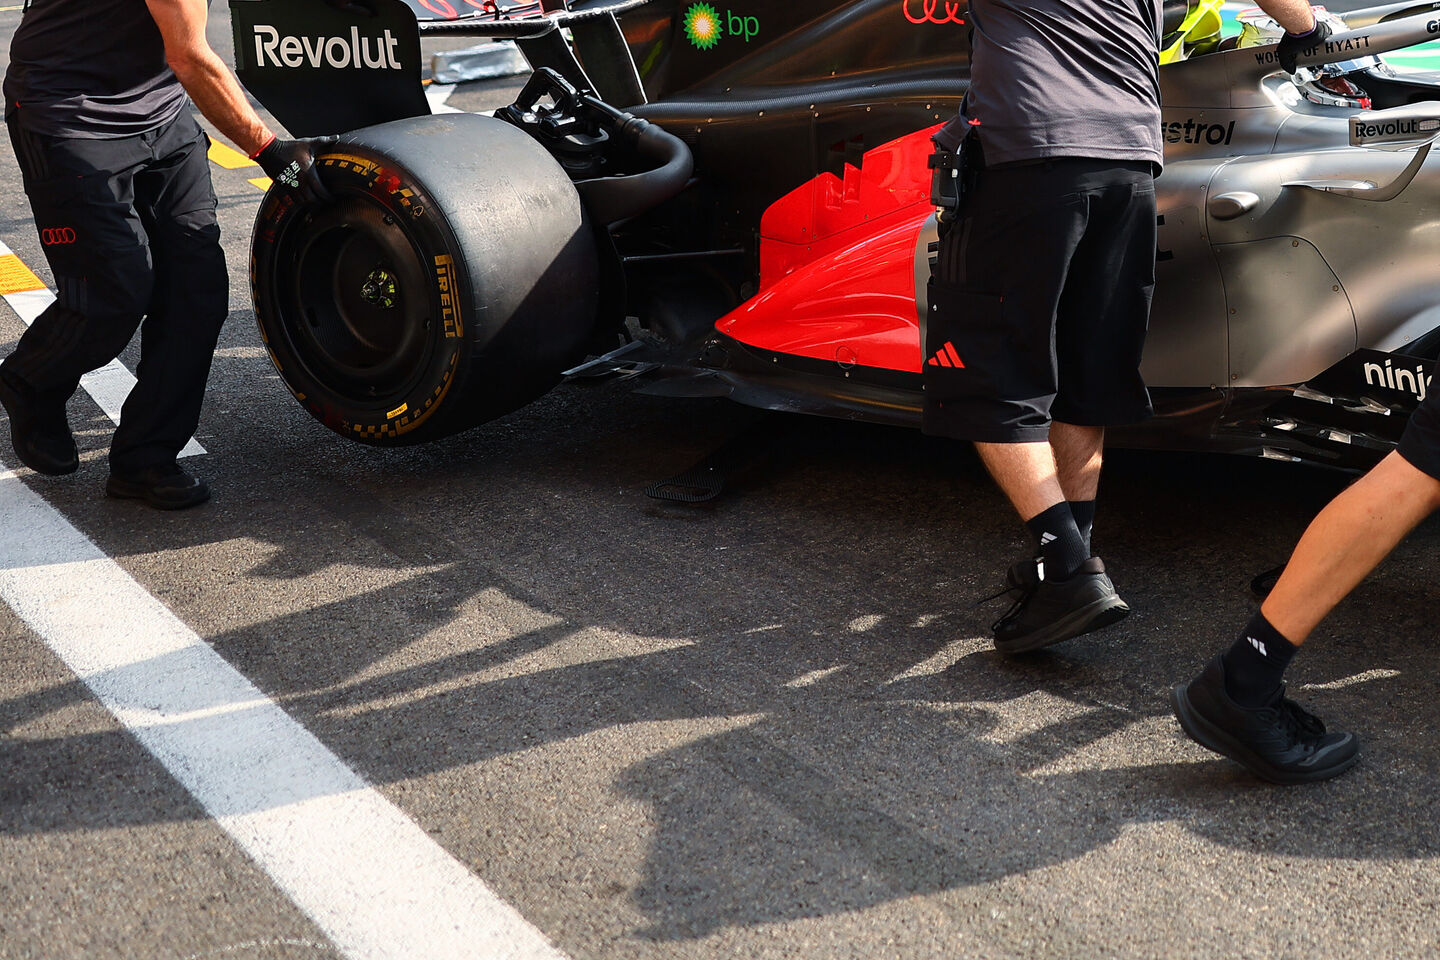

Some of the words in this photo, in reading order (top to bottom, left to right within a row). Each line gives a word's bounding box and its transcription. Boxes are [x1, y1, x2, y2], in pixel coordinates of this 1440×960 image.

[727, 9, 760, 42] bp
[254, 25, 402, 70] Revolut
[1302, 45, 1320, 58] OF
[1325, 35, 1371, 54] HYATT
[1162, 119, 1236, 145] strol
[1355, 119, 1418, 138] Revolut
[434, 253, 464, 339] PIRELLI
[1363, 358, 1434, 402] ninj
